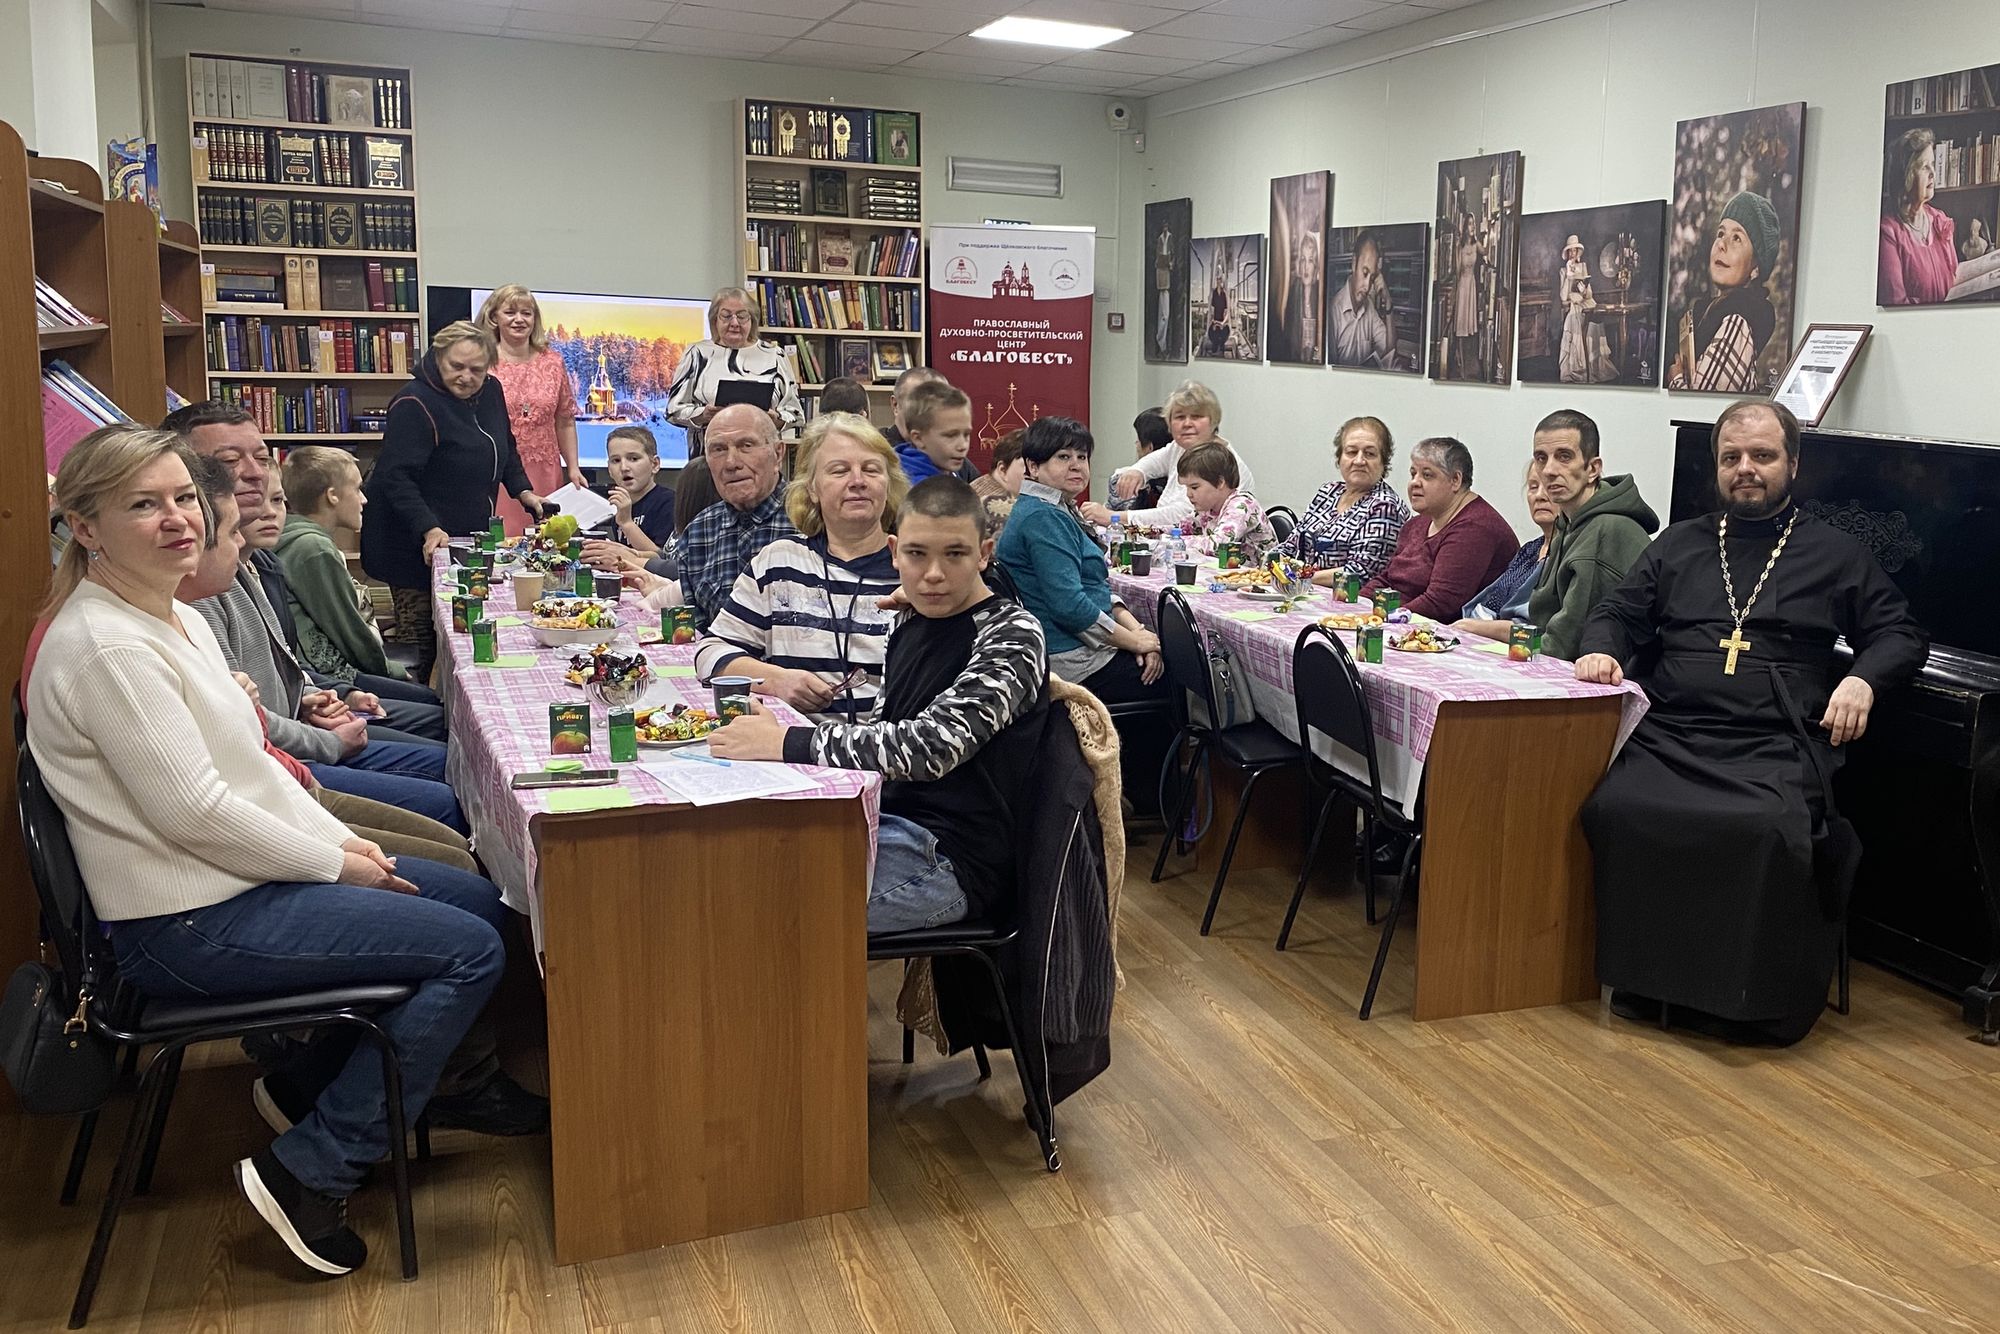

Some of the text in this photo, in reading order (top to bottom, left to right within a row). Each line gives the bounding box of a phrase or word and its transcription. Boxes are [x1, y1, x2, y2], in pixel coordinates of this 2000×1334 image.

[973, 319, 1050, 329] ПРАВОСЛАВНЫЙ
[939, 328, 1084, 341] ДУХОВНО-ПРОСВЕТИТЕЛЬСКИЙ
[997, 340, 1027, 350] ЦЕНТР
[950, 350, 1073, 365] «БЛАГОВЕСТ»
